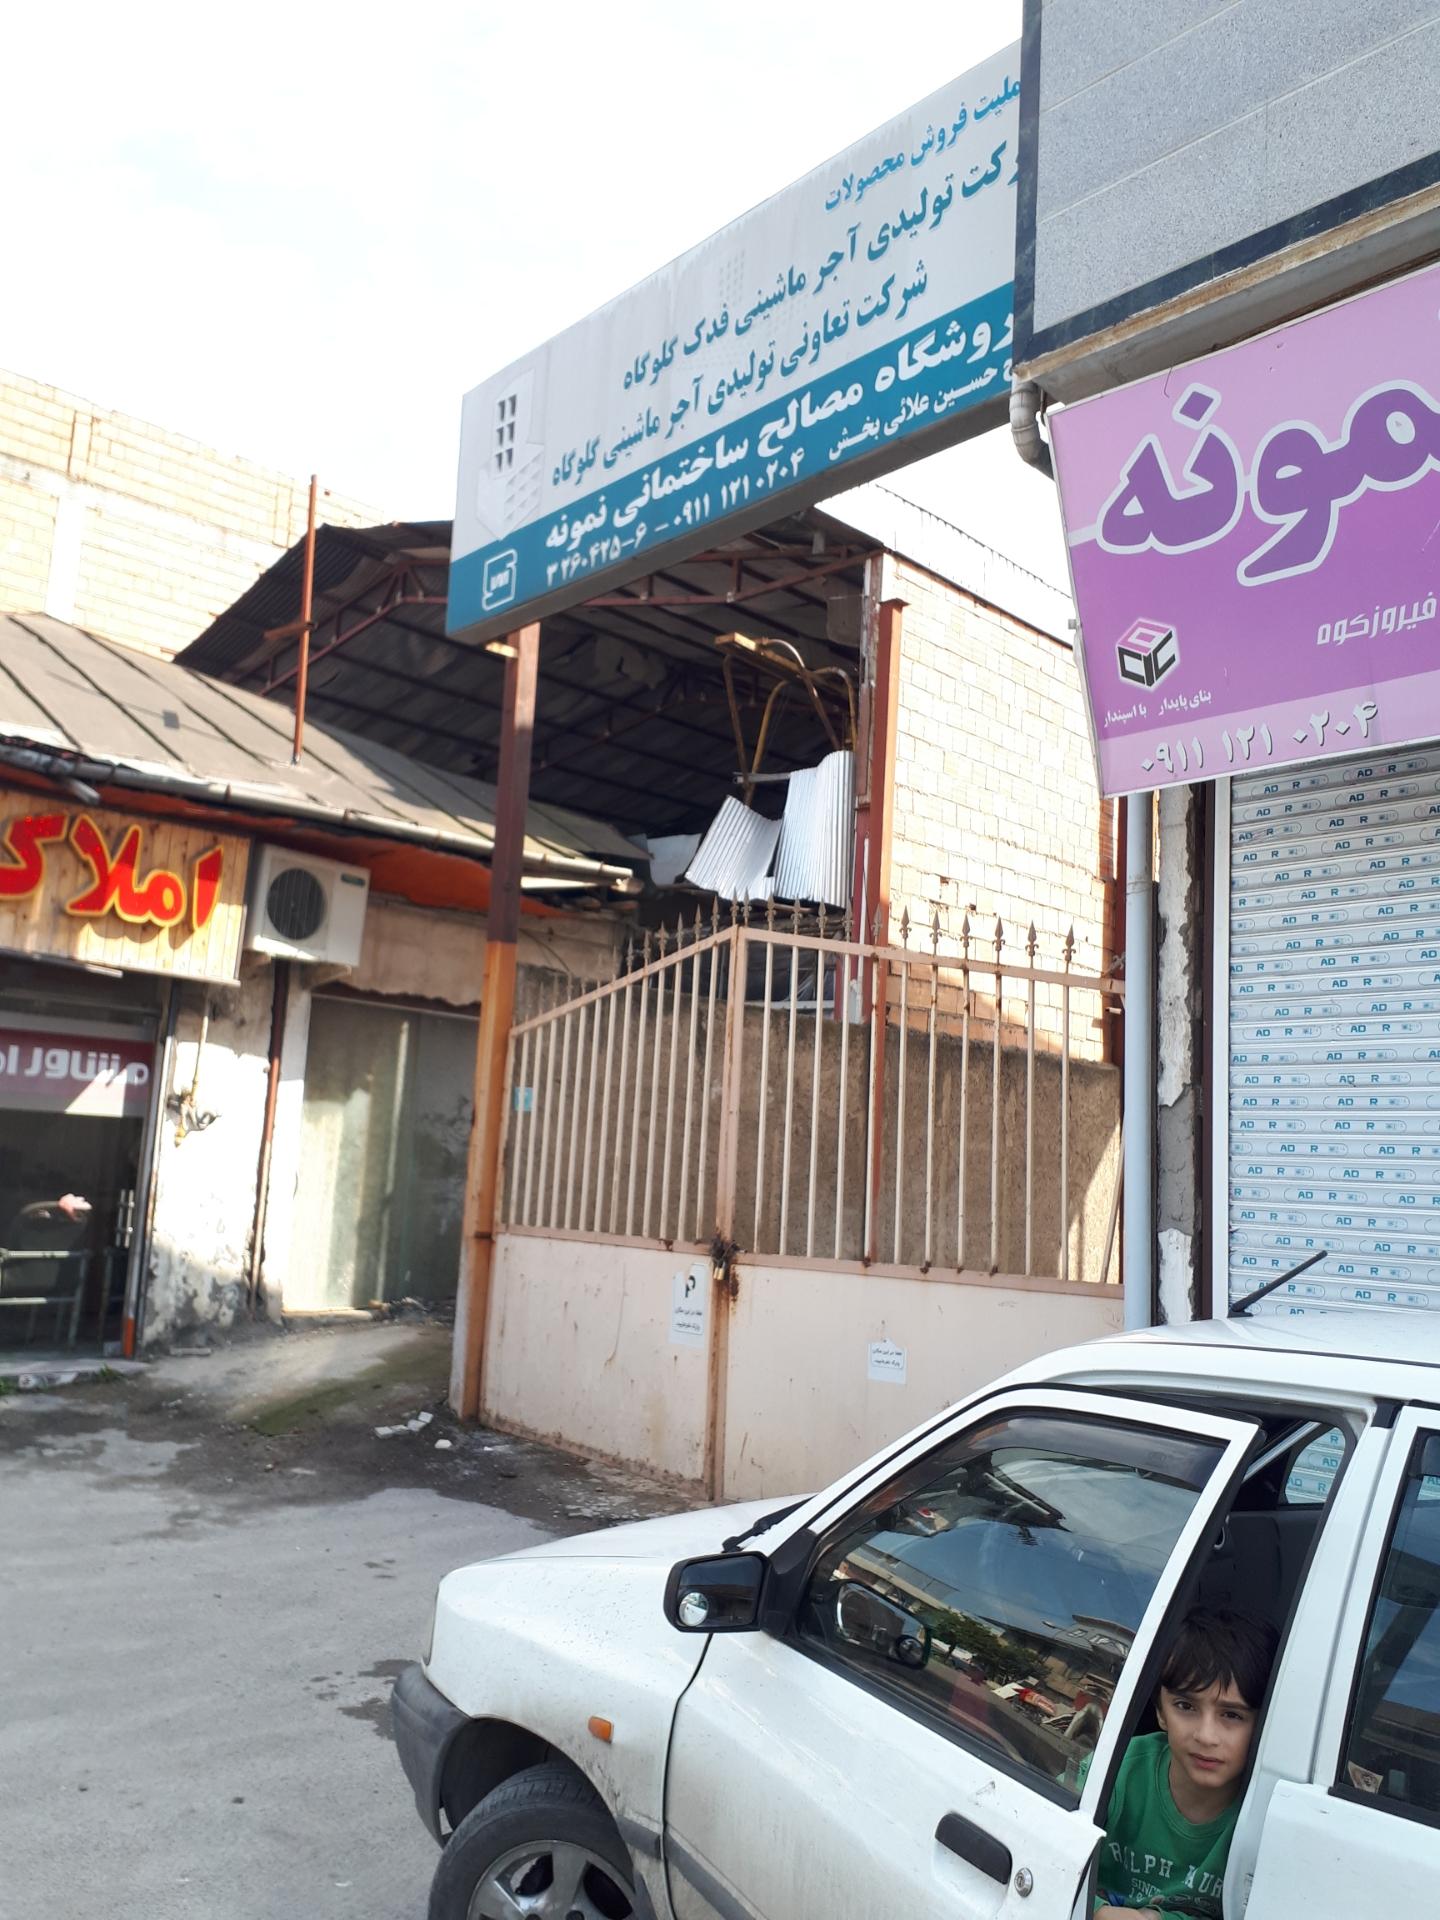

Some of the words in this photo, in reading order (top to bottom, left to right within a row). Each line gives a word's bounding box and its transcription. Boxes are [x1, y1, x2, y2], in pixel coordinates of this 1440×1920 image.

[911, 102, 967, 166] فروش
[825, 152, 904, 210] محصولات
[962, 140, 1019, 198] رکت
[868, 173, 954, 261] تولیدی
[813, 222, 861, 294] آجر
[735, 265, 806, 336] ماشینی
[856, 259, 927, 327] شرکت
[683, 303, 729, 355] فدک
[781, 299, 850, 377] تعاونی
[874, 313, 1014, 393] روشگاه
[665, 374, 704, 439] آجر
[707, 339, 776, 415] تولیدی
[934, 367, 998, 413] حسین
[603, 407, 660, 469] ماشینی
[757, 383, 863, 458] مصالح
[828, 415, 881, 461] بخش
[613, 435, 749, 528] ساختمانی
[673, 493, 710, 525] ۰۹۱۱
[721, 475, 750, 510] ۱۲۱
[755, 447, 805, 488] ۰۲۰۴
[1096, 378, 1440, 588] مونه
[545, 495, 607, 551] نمونه
[1316, 591, 1438, 646] فیروزکوه
[1141, 736, 1204, 774] ۰۹۱۱
[1222, 722, 1273, 762] ۱۲۱
[1293, 700, 1378, 746] ۰۲۰۴
[24, 1046, 149, 1085] مشاور
